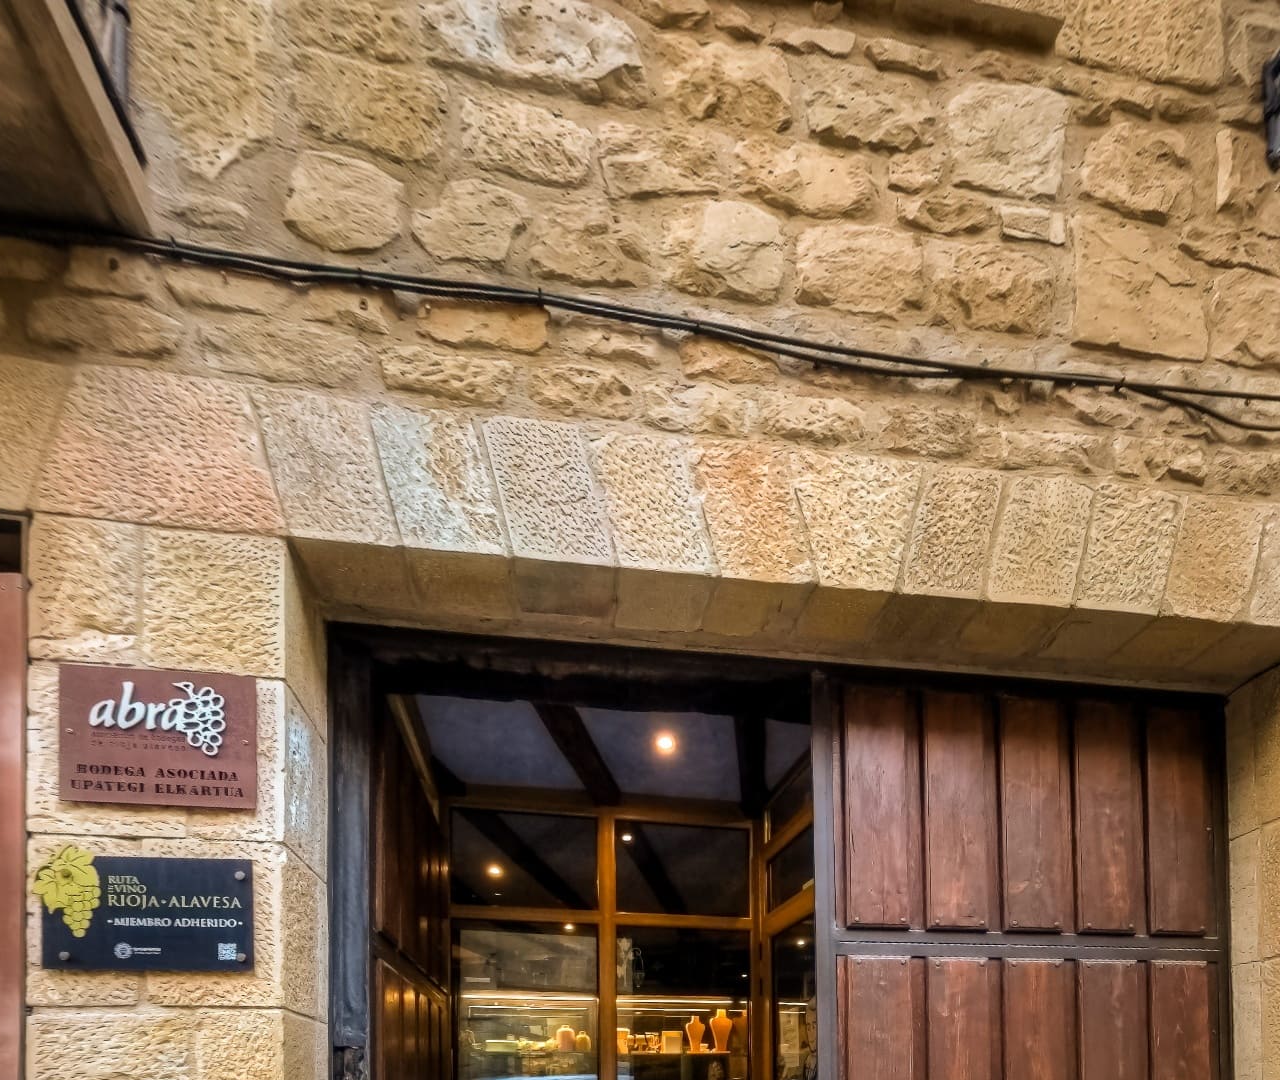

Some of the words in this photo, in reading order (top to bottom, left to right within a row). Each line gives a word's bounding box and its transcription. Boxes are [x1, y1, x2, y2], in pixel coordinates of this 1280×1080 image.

[88, 681, 186, 731] abra
[76, 763, 145, 778] BODEGA
[155, 767, 239, 782] ASOCIADA
[71, 779, 145, 793] UPATEGI
[155, 782, 244, 798] ELKARTUA
[108, 875, 140, 884] RUTA
[114, 884, 147, 894] VINO
